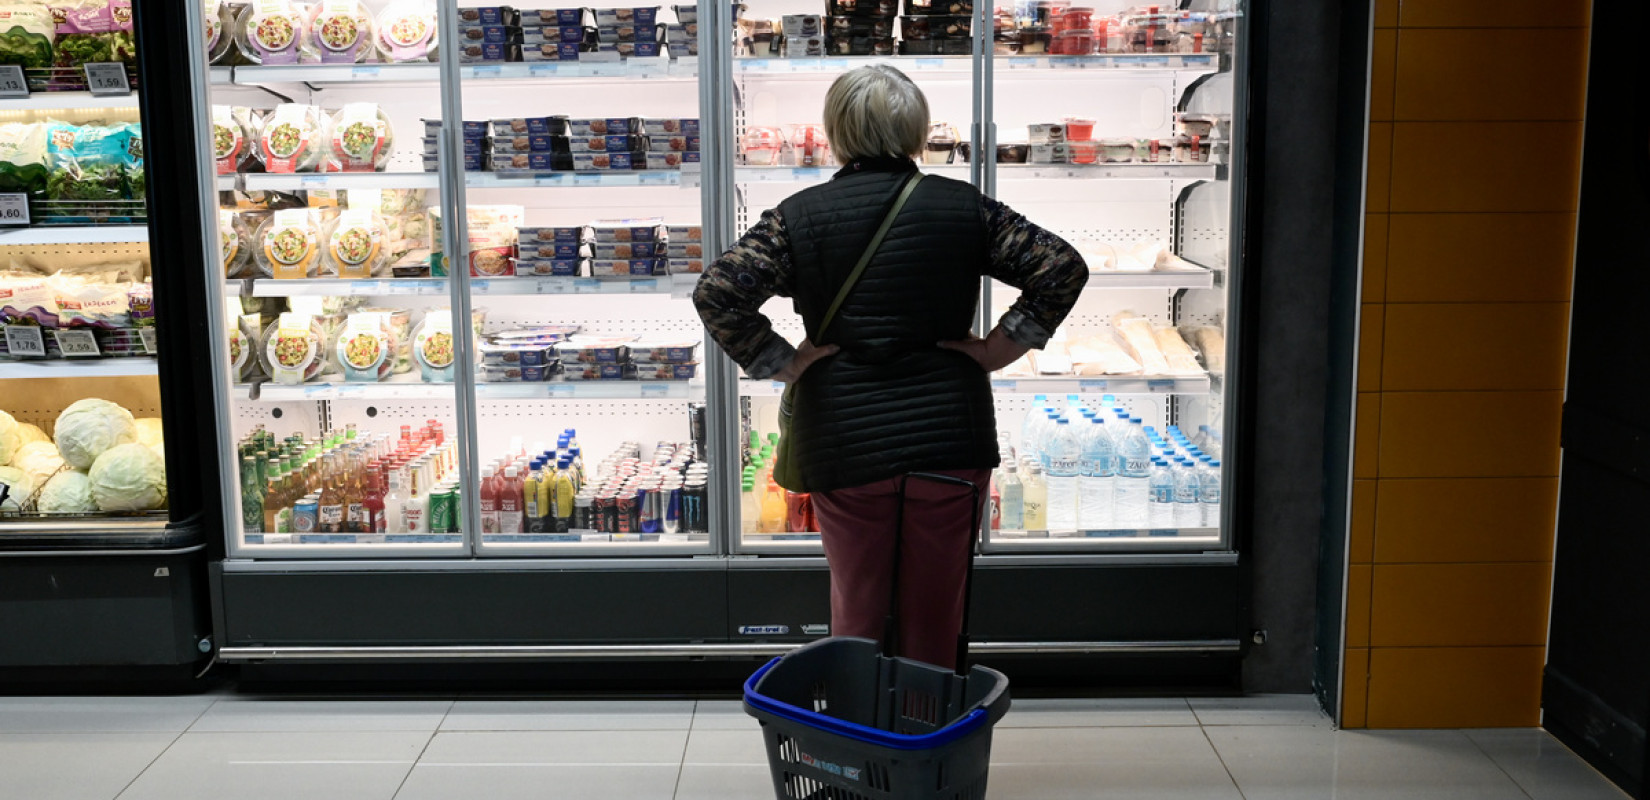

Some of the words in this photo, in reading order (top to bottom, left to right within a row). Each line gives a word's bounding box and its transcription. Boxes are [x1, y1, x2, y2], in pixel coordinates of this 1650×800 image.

[0, 80, 19, 90] ,13
[97, 78, 119, 88] 1,59
[16, 340, 37, 351] 1,78
[67, 343, 90, 352] 2,59
